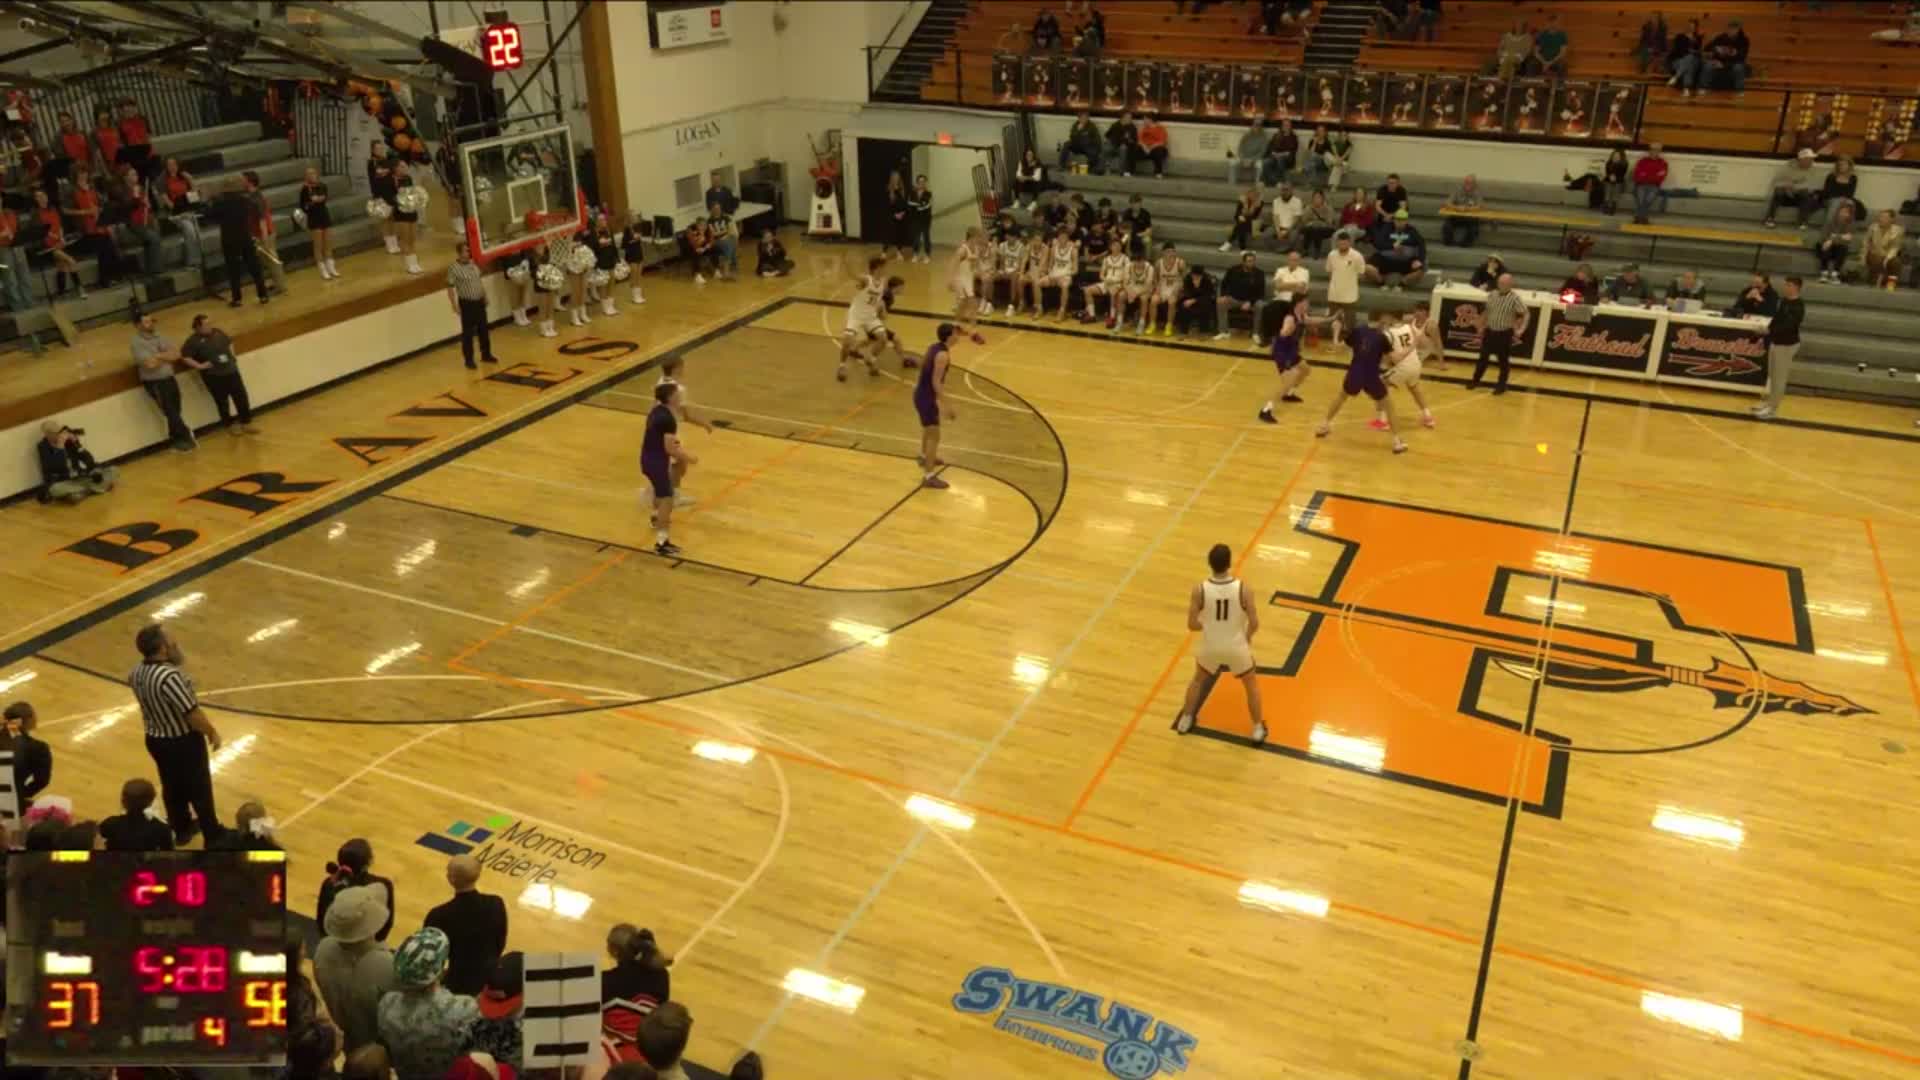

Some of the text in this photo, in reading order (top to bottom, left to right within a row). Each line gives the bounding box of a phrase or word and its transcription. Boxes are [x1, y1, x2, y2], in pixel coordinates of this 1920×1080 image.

[488, 27, 520, 66] 22
[673, 119, 721, 146] LOGAN
[1398, 332, 1411, 347] 12
[48, 336, 640, 574] BRAVES
[1215, 598, 1229, 621] 11
[474, 842, 558, 884] Maierle
[498, 819, 607, 870] Morrison
[135, 946, 228, 992] 5:28
[47, 981, 100, 1028] 37
[952, 965, 1199, 1072] SWANK
[202, 1016, 226, 1046] 4
